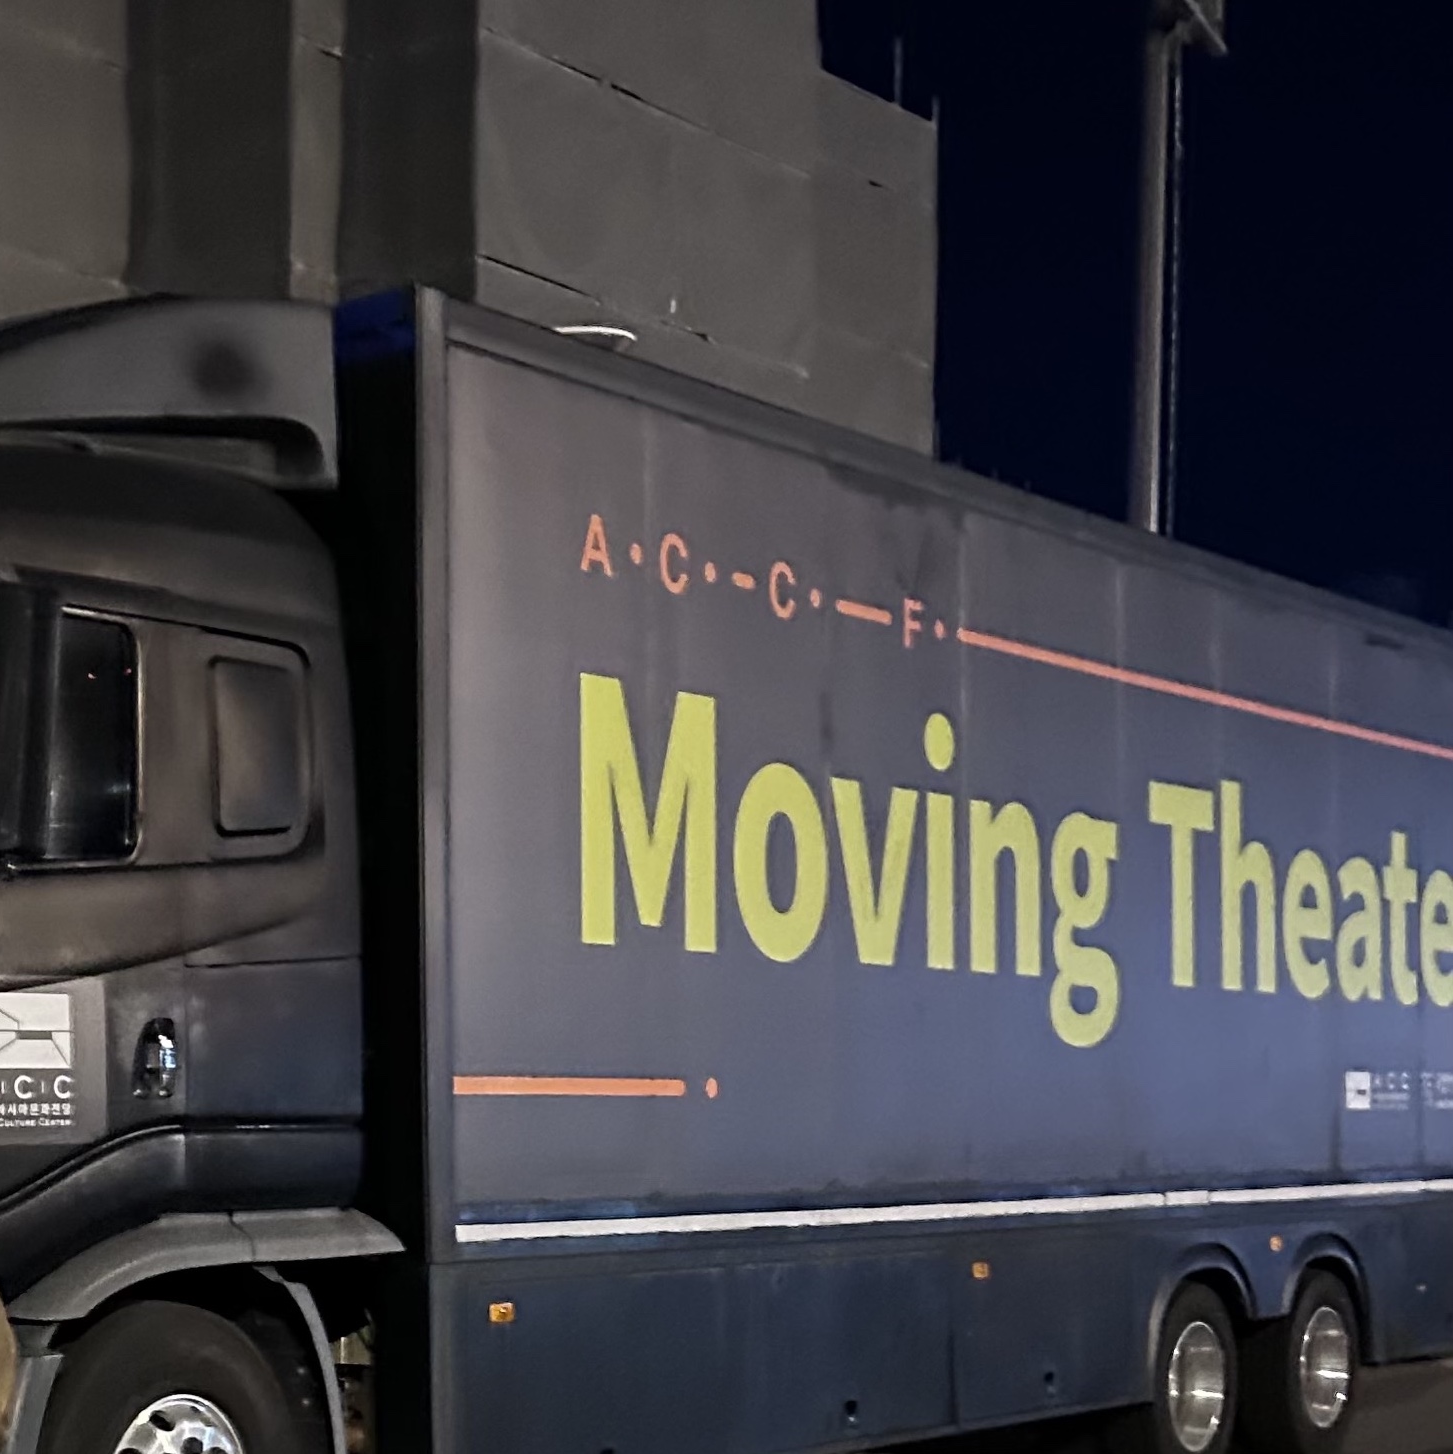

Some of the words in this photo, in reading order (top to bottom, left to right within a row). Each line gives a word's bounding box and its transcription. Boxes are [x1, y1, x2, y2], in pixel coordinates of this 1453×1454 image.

[580, 514, 613, 577] A
[660, 533, 689, 594] C
[769, 561, 796, 620] C
[903, 597, 925, 648] F
[580, 672, 1119, 1047] Moving
